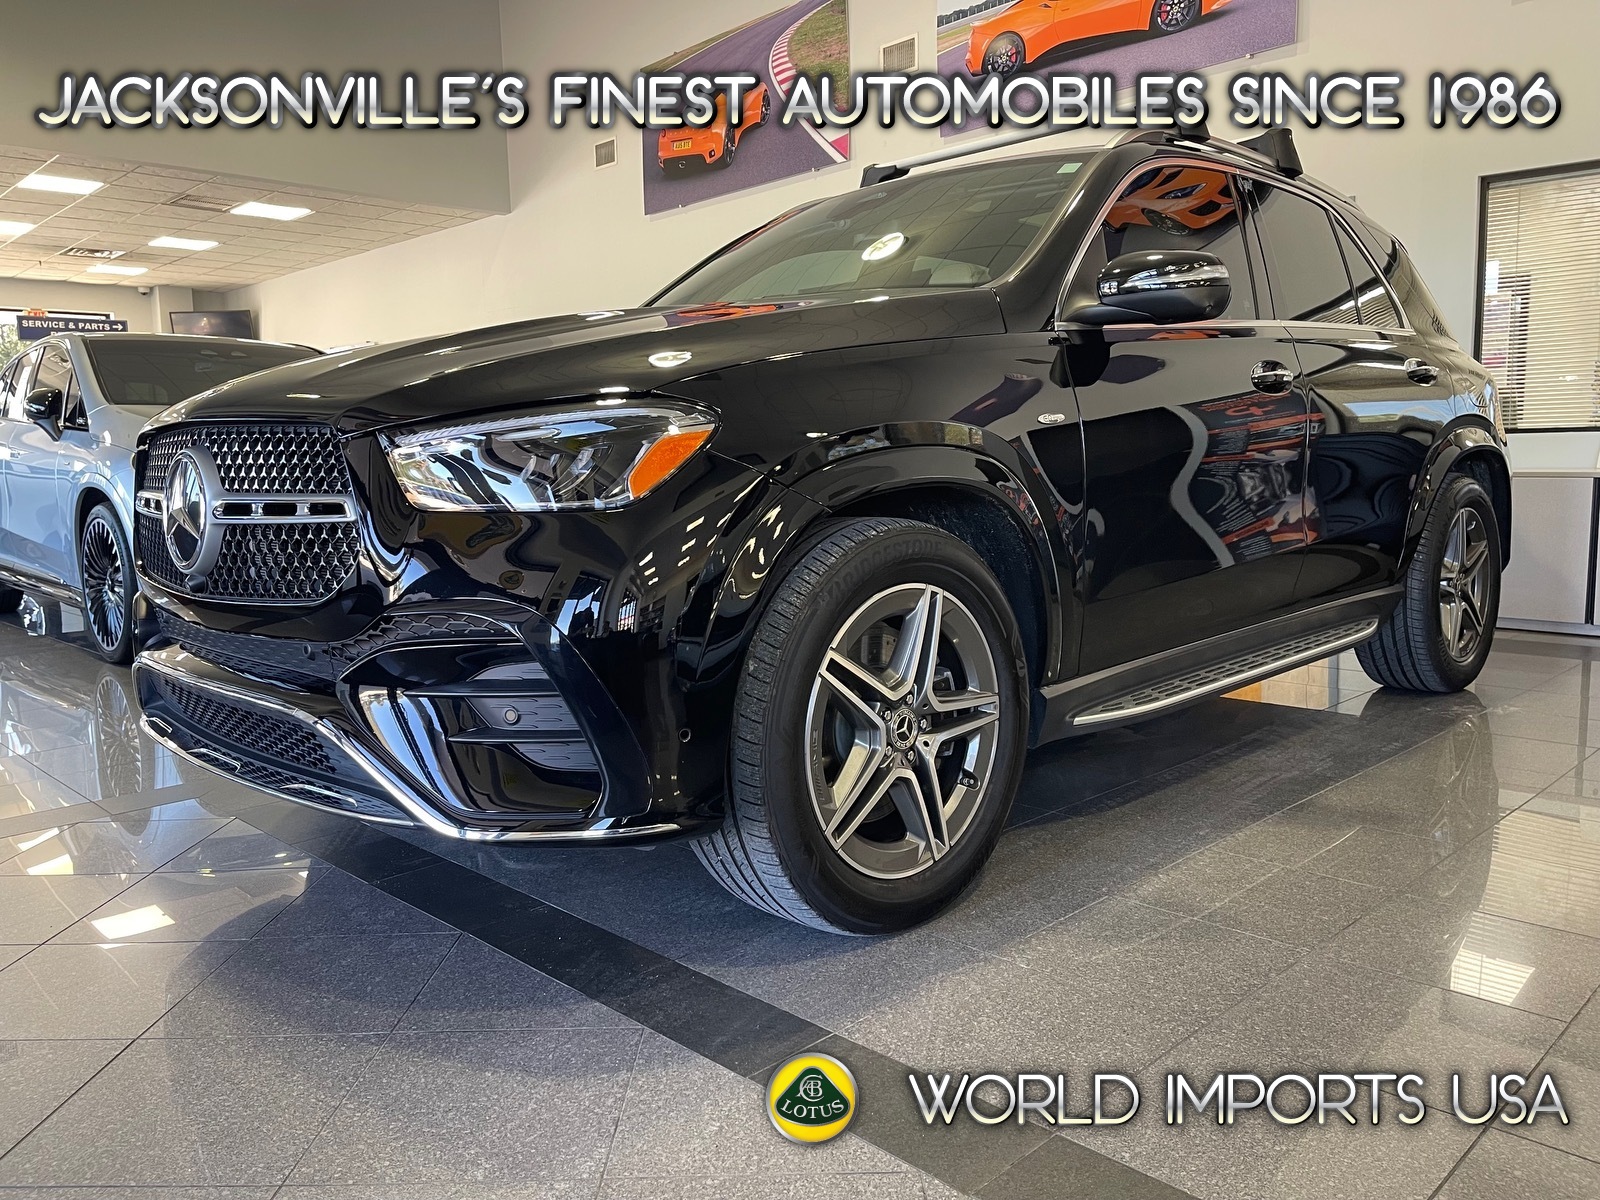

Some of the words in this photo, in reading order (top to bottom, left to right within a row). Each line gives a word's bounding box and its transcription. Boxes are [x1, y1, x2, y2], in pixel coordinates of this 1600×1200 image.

[21, 319, 66, 329] SERVICE
[68, 321, 76, 329] &
[78, 321, 111, 331] PARTS
